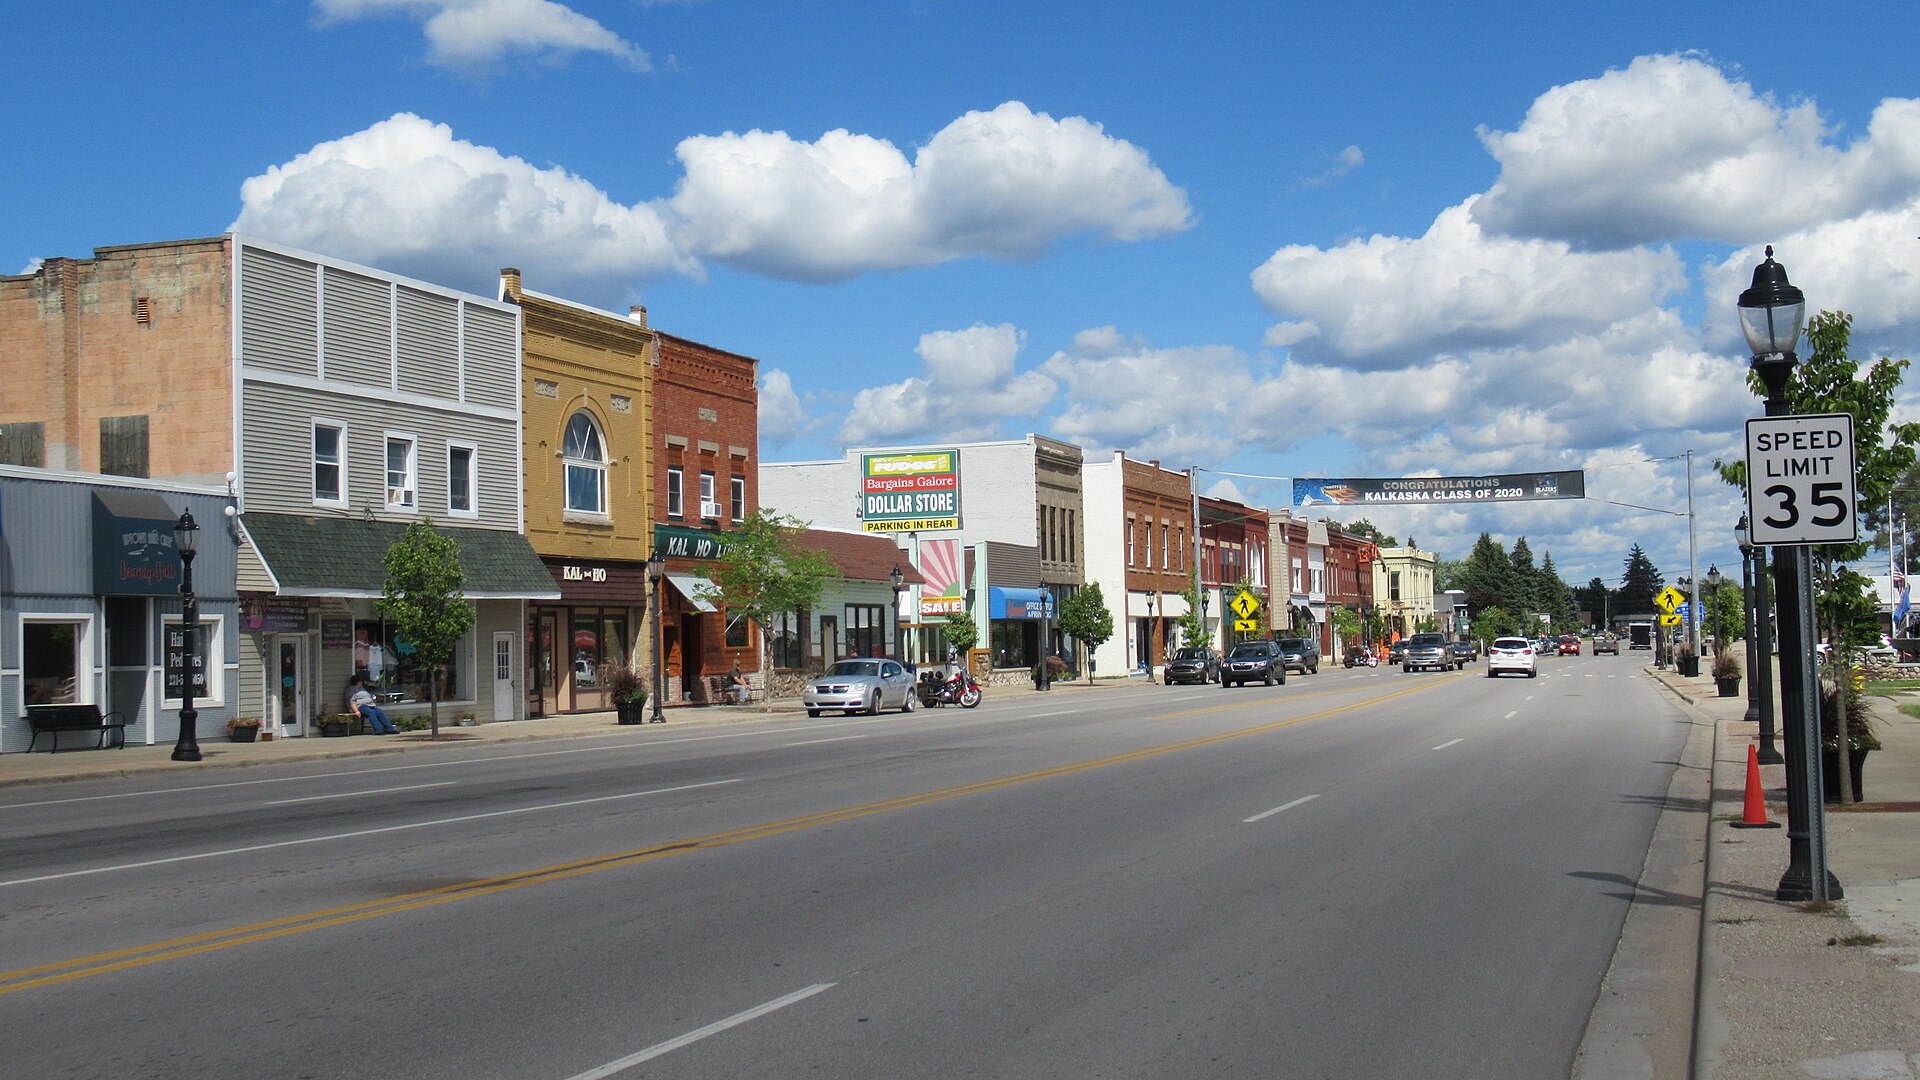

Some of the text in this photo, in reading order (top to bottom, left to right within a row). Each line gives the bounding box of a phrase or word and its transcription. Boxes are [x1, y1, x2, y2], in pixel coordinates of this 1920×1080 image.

[1757, 430, 1843, 452] SPEED
[1766, 456, 1834, 478] LIMIT
[867, 477, 953, 491] Bargains Galore
[1383, 478, 1500, 490] CONGRATULATIONS
[1364, 487, 1523, 501] KALKASKA CLASS OF 2020
[868, 493, 953, 514] DOLLAR STORE
[1763, 482, 1847, 529] 35
[868, 519, 953, 531] PARKING IN REAR
[667, 537, 688, 556] KAL
[695, 539, 711, 557] HO
[922, 602, 961, 613] SALE
